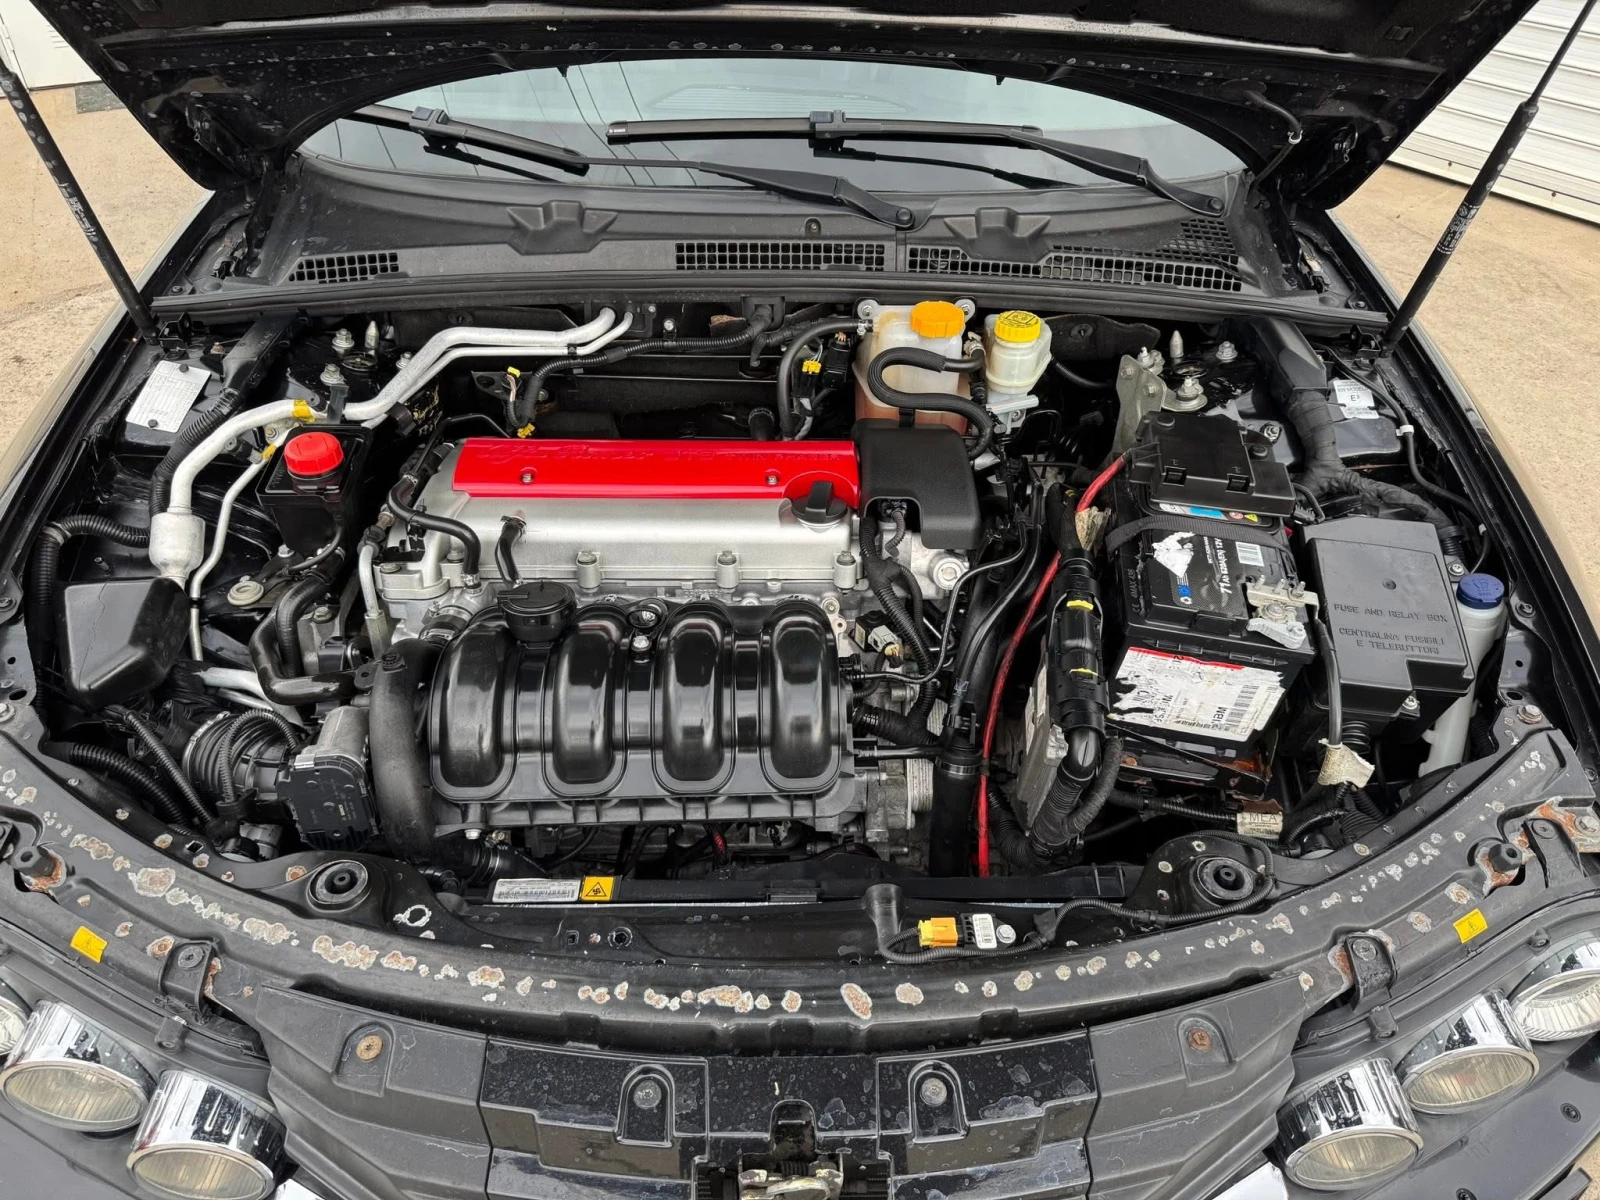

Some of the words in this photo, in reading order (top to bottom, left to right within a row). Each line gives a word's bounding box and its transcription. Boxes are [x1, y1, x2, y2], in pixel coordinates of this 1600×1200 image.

[1333, 603, 1359, 614] FUSE
[1364, 608, 1383, 617] AND
[1388, 610, 1421, 620] RELAY
[1427, 613, 1448, 623] BOX
[1338, 627, 1400, 641] CENTRALINA
[1404, 635, 1444, 646] FUSIBILI
[1356, 639, 1363, 647] E
[1368, 640, 1439, 655] TELERUTTORI
